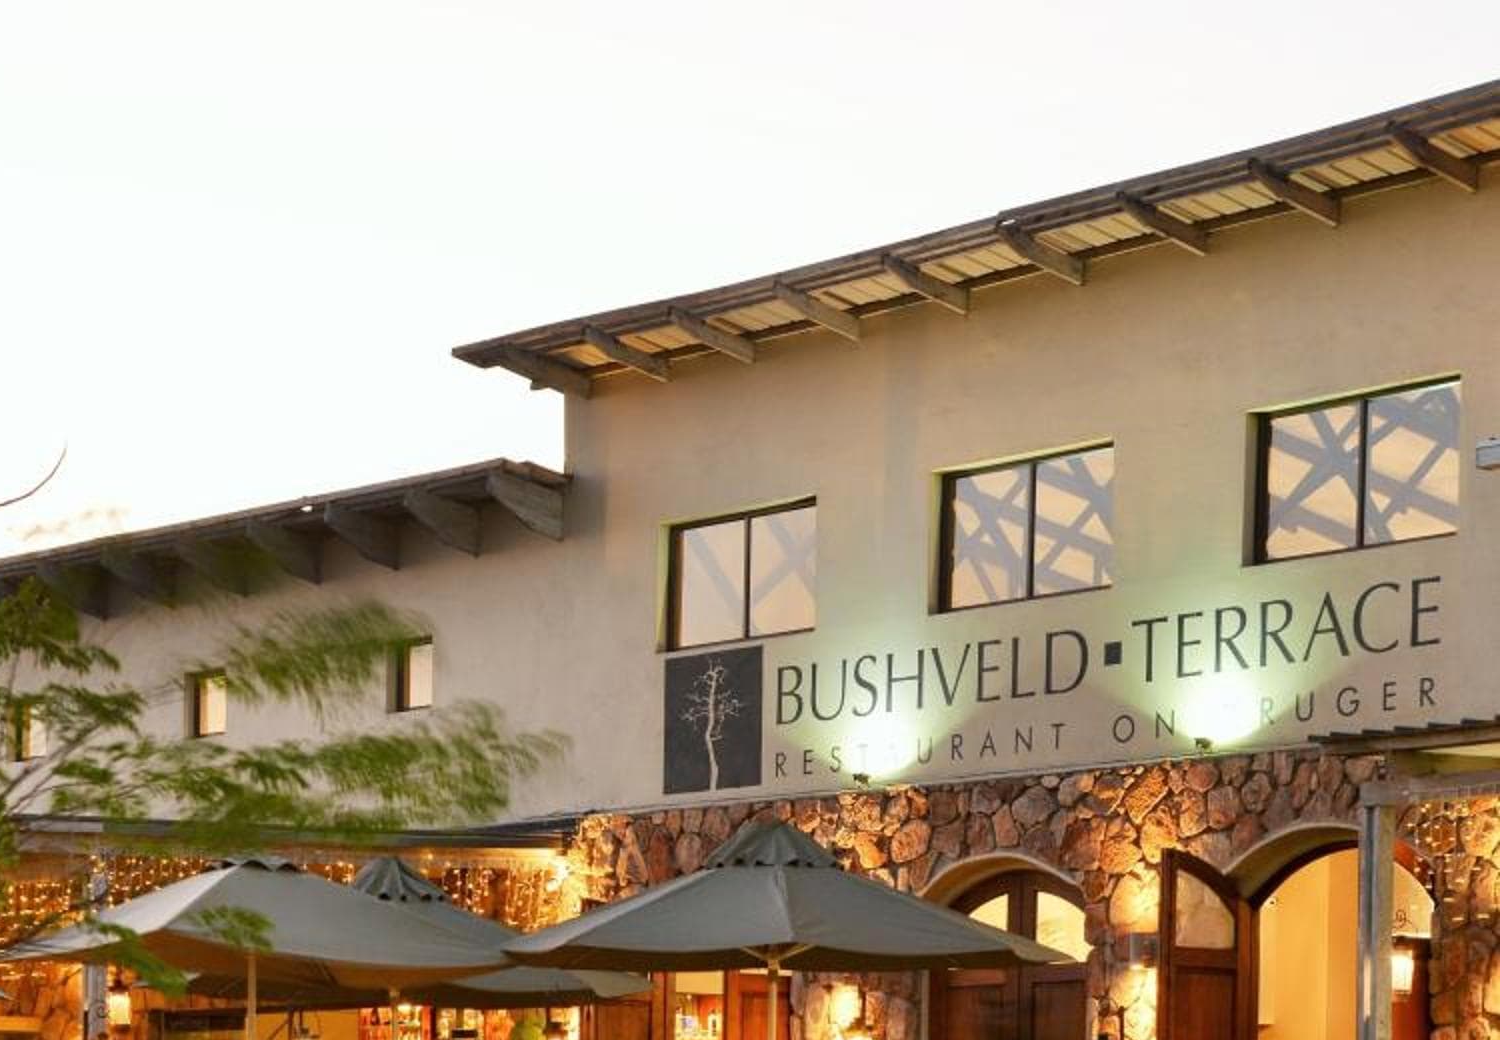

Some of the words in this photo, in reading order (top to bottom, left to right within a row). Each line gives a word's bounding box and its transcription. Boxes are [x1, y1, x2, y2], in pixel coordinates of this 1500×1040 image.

[775, 630, 1090, 726] BUSHVELD
[1131, 575, 1442, 683] TERRACE
[774, 722, 1067, 778] RESTURANT
[1112, 709, 1176, 743] ON
[1218, 677, 1437, 730] RUGER
